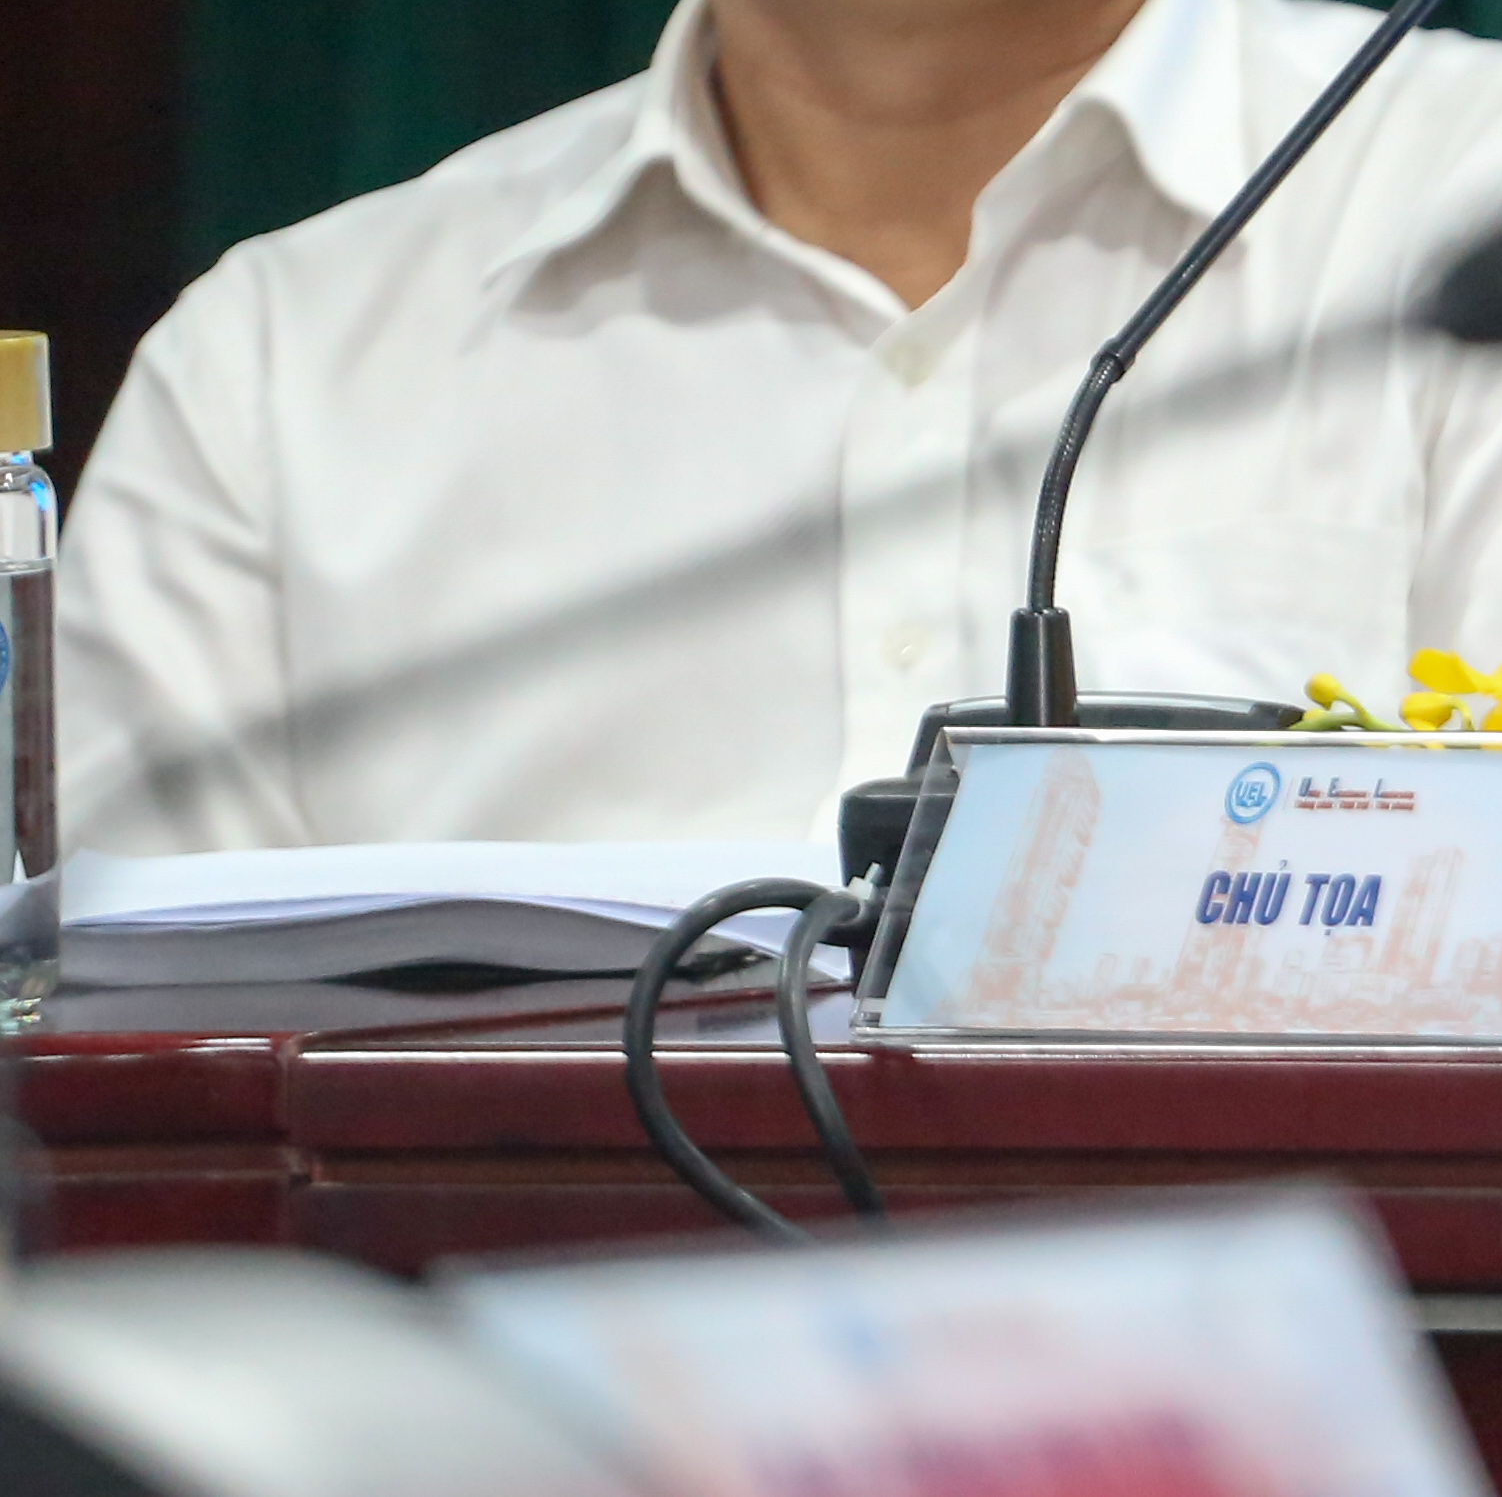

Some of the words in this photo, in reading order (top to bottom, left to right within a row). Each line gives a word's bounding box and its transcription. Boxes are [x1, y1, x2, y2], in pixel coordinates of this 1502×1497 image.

[1236, 781, 1267, 803] UEL
[1195, 859, 1292, 926] CHỦ
[1299, 873, 1382, 936] TỌA
